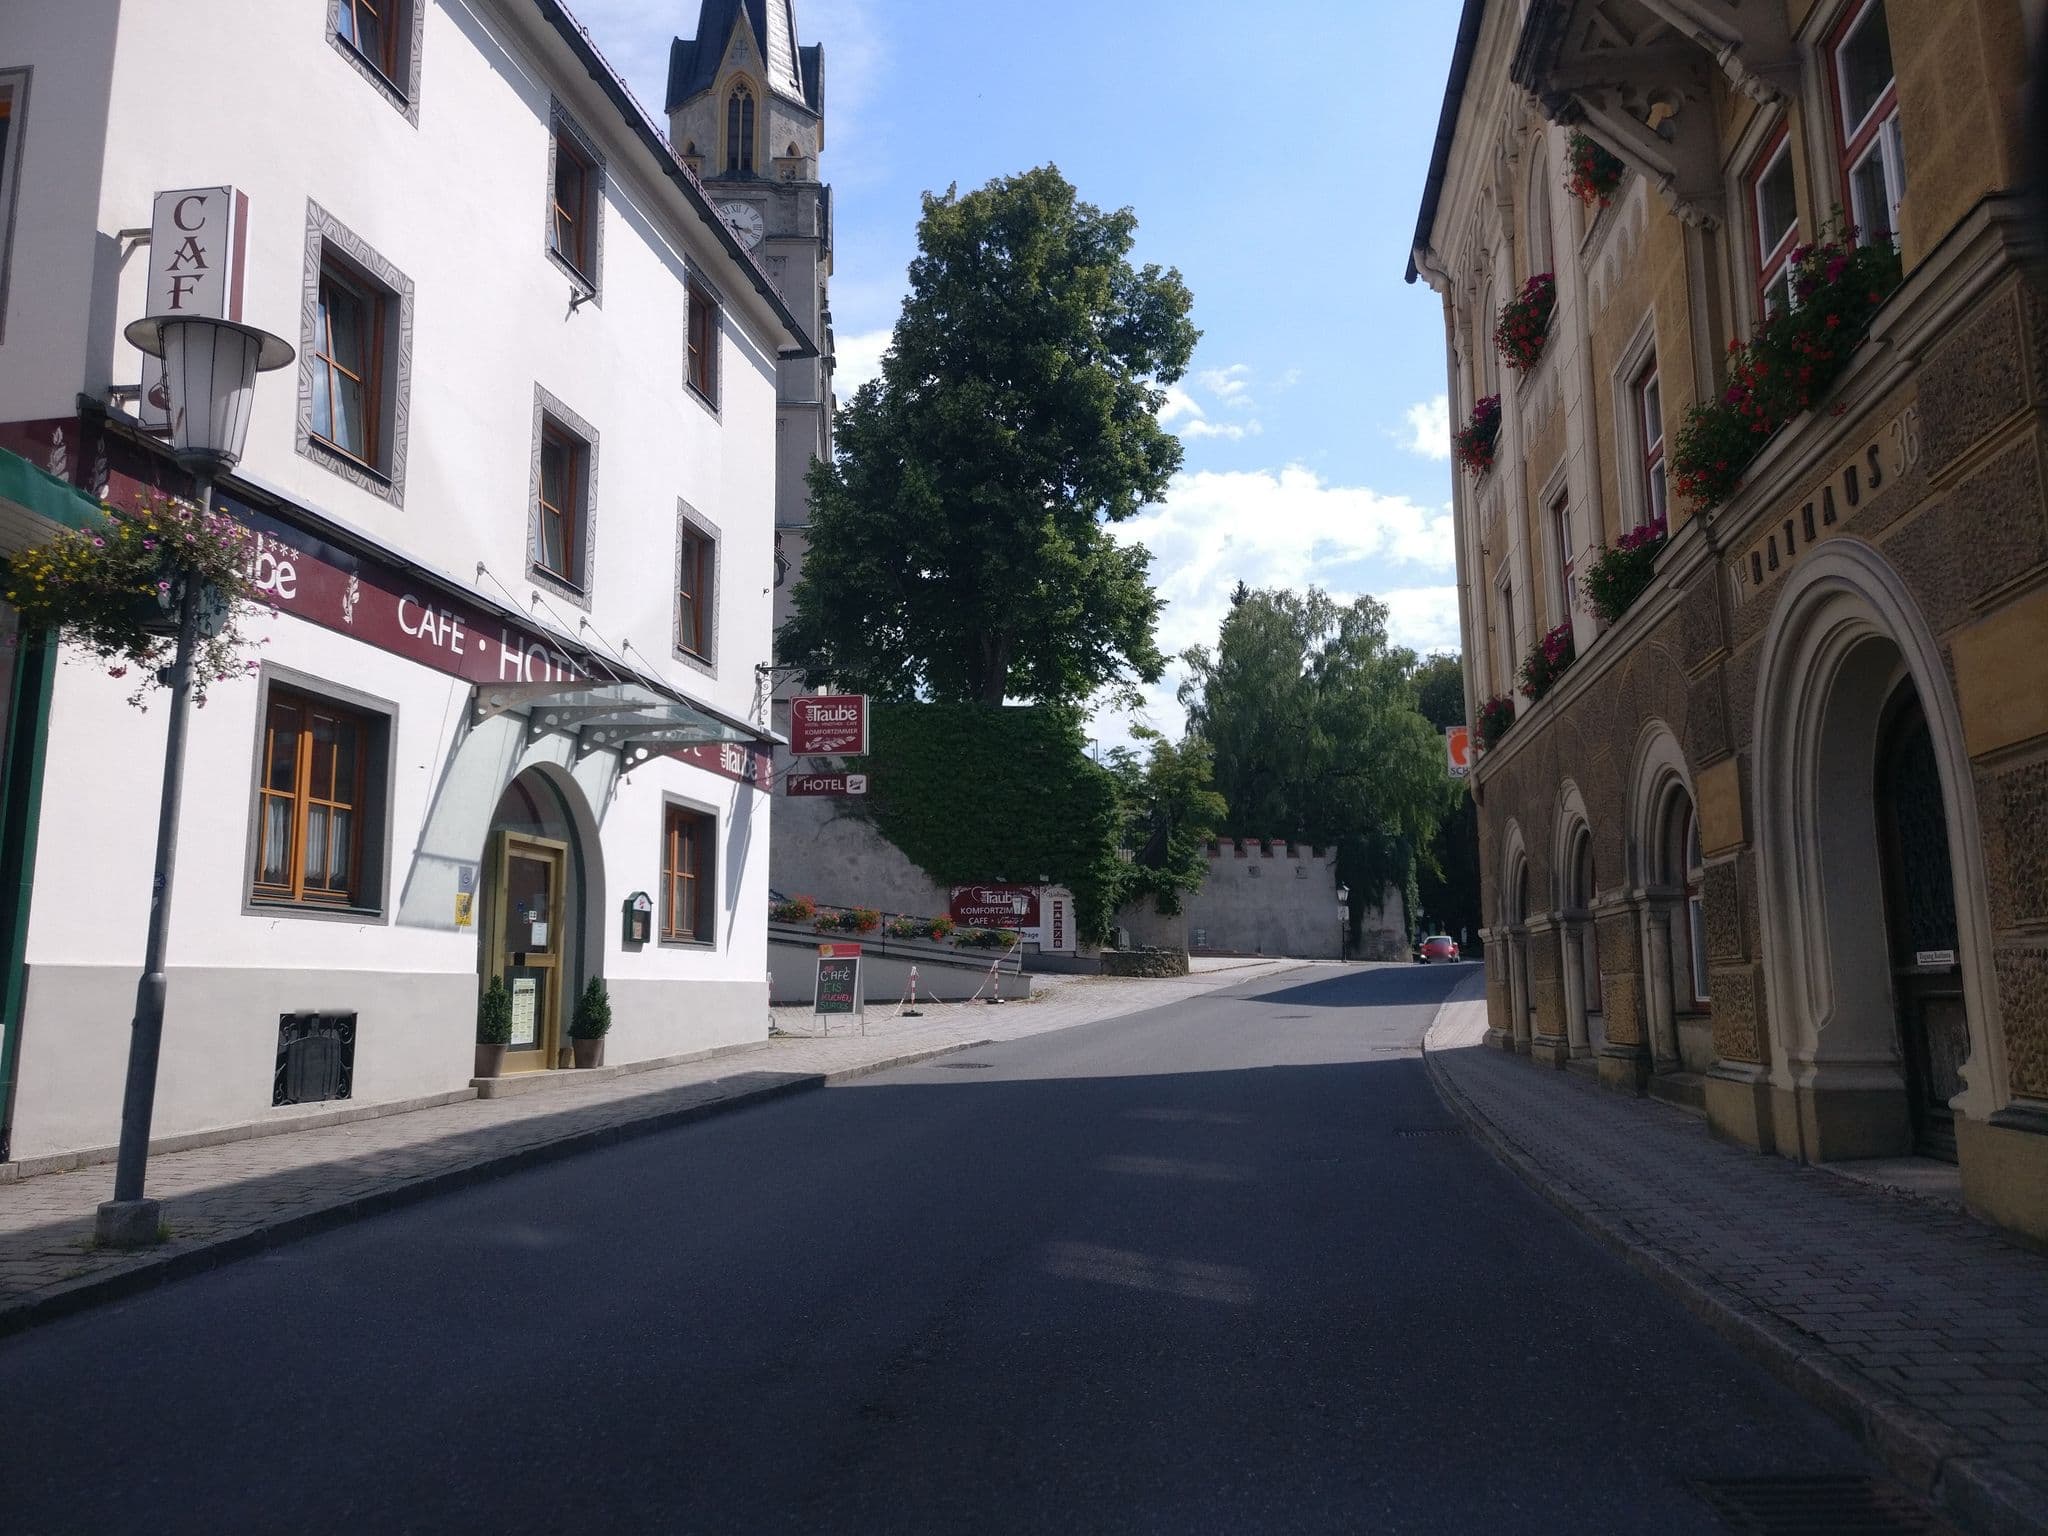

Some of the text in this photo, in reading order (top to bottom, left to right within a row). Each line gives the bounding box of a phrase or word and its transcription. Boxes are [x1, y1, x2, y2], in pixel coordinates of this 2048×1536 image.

[167, 194, 209, 310] CAF
[1751, 443, 1882, 586] RATHAUS
[398, 593, 575, 682] CAFE HOT
[805, 703, 858, 722] Traube
[804, 728, 858, 736] KOMFORTZIMMER
[1450, 767, 1469, 775] SCH
[803, 779, 845, 791] HOTEL
[980, 890, 1013, 904] Traub
[960, 907, 1031, 915] KOMFORTZIMR
